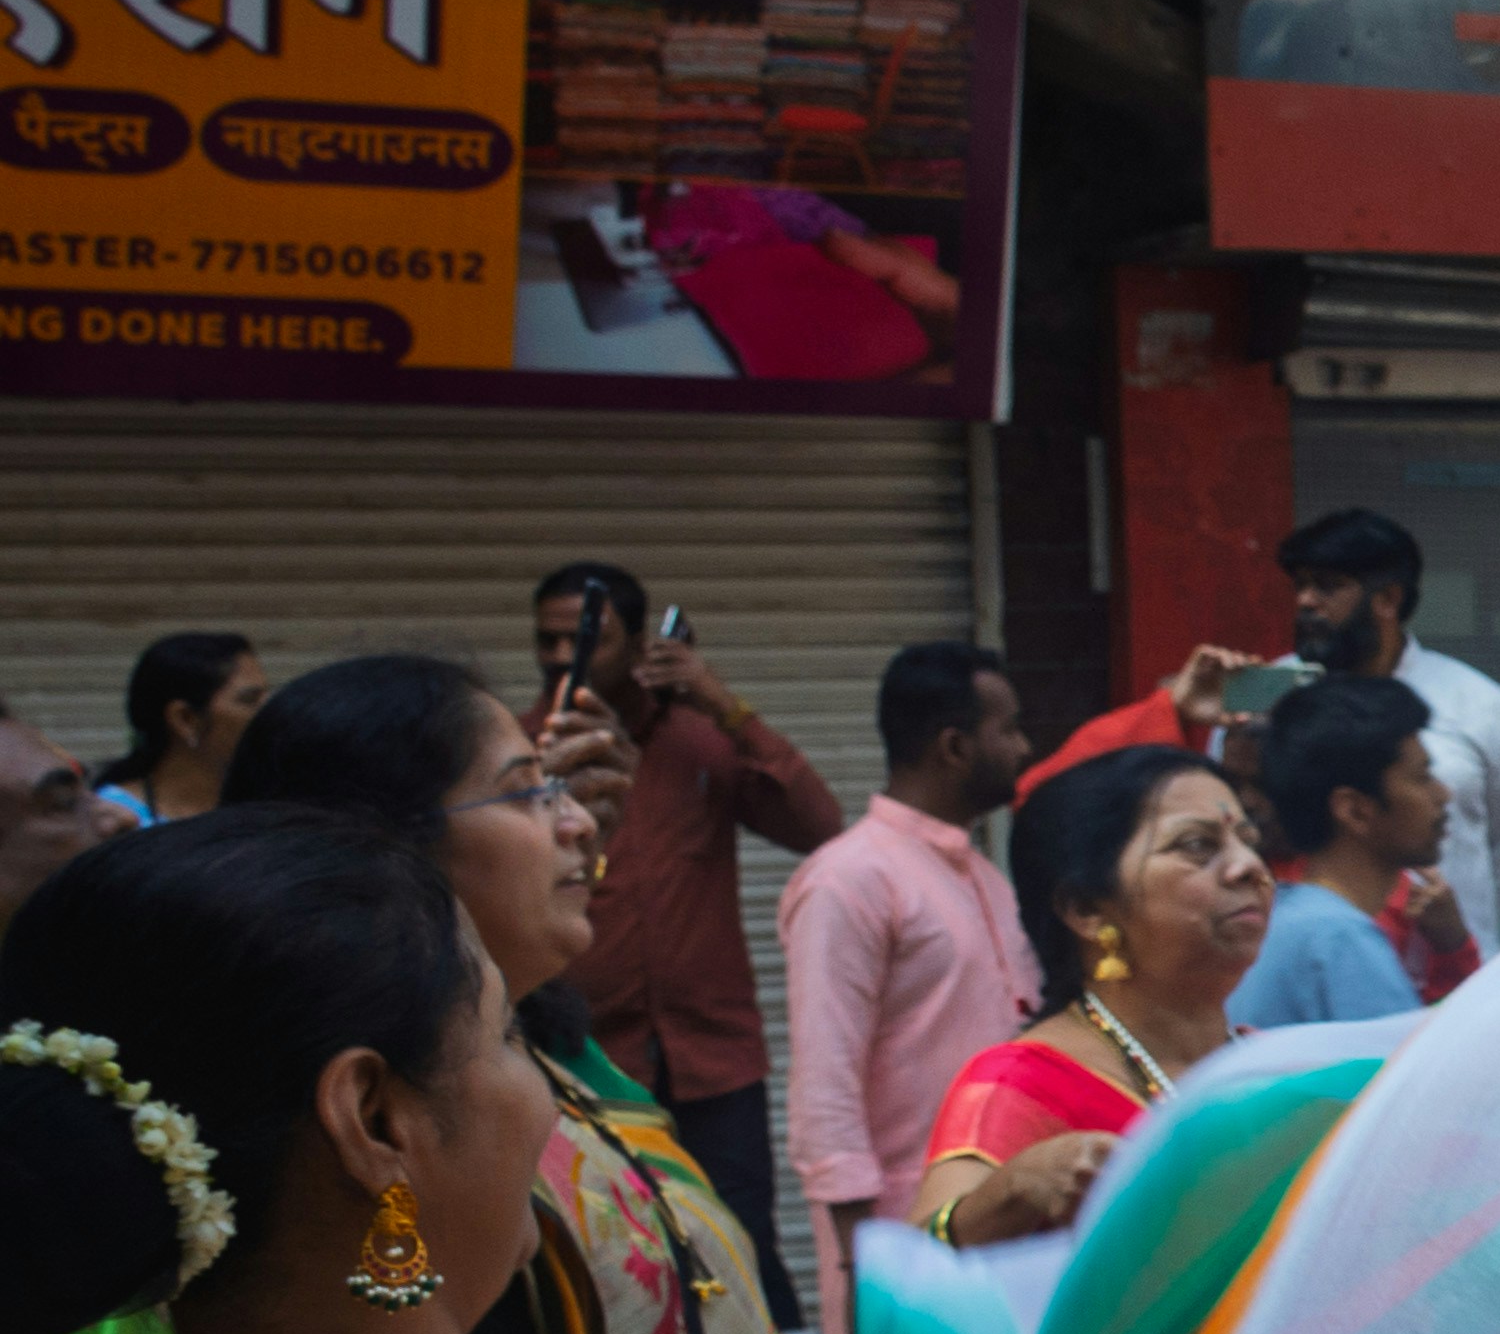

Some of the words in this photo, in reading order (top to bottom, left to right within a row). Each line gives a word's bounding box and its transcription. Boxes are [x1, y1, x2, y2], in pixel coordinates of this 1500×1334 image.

[191, 240, 486, 284] 7715006612
[80, 308, 225, 348] DONE
[240, 315, 384, 353] HERE.
